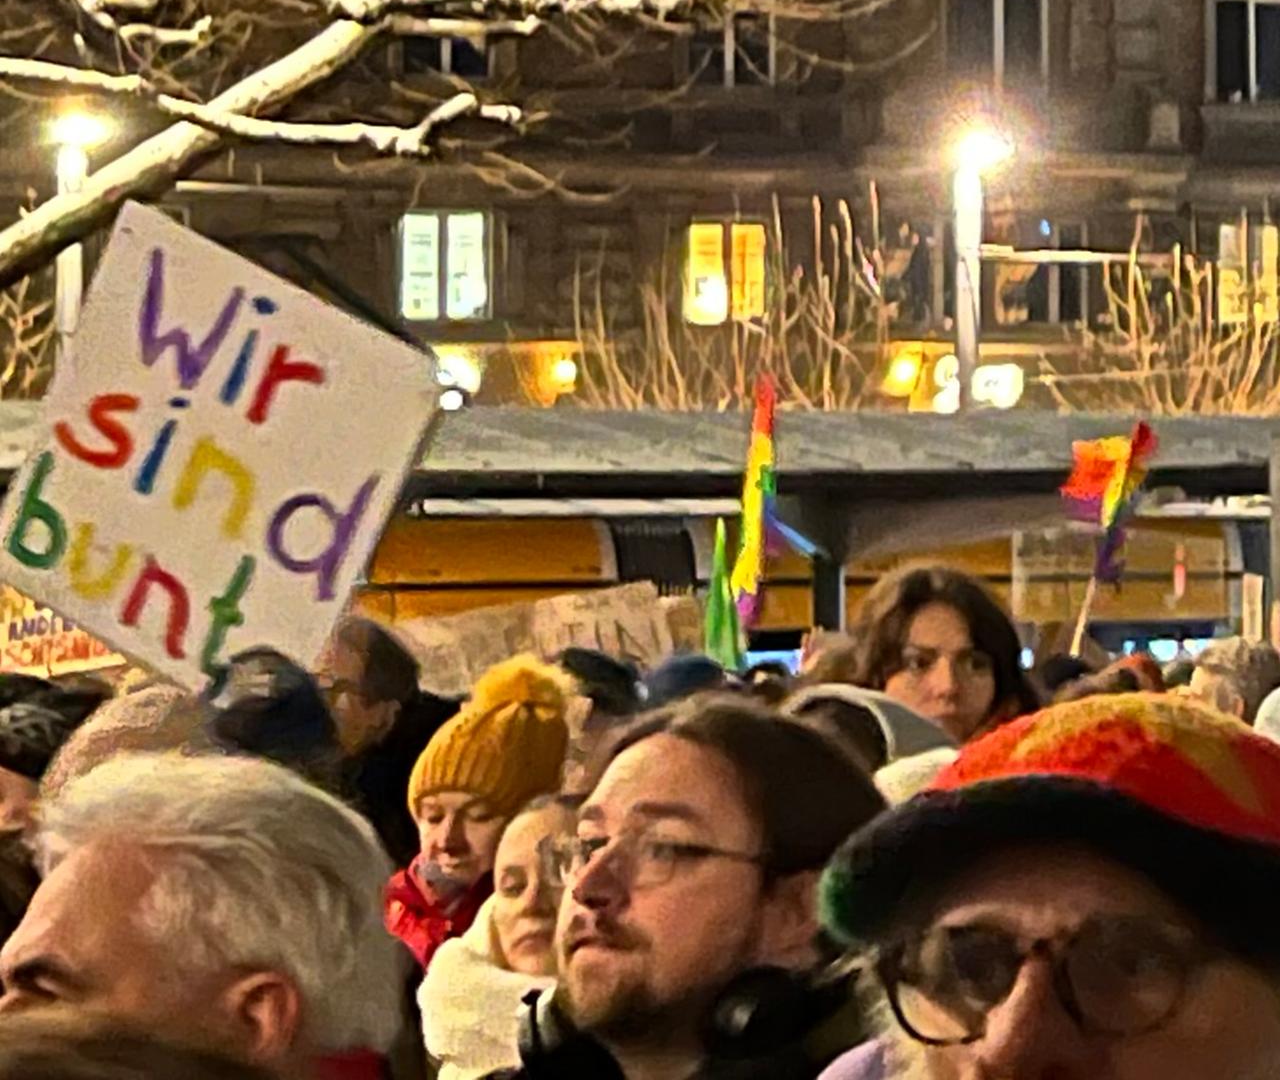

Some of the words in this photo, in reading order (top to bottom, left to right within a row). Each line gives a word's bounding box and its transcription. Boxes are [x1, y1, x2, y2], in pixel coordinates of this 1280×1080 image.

[137, 248, 326, 424] Wir
[6, 451, 256, 692] bunt
[55, 393, 380, 602] sind
